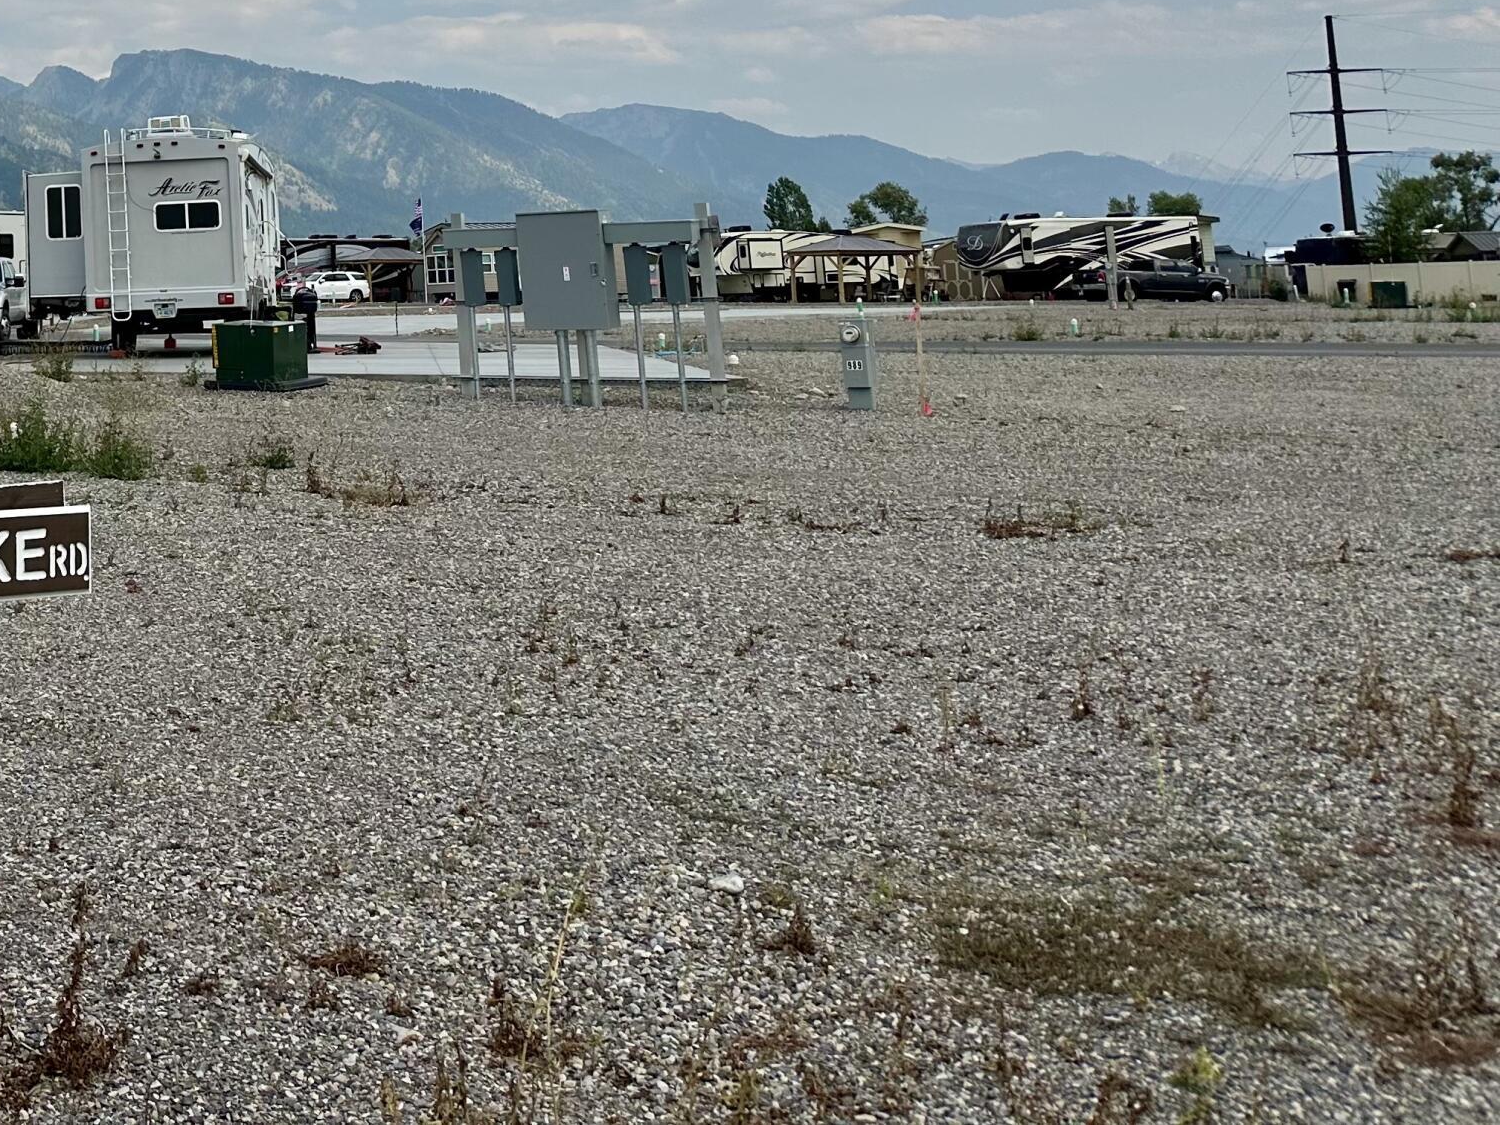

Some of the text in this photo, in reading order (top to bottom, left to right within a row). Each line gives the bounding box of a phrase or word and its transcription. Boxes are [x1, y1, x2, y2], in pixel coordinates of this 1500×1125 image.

[148, 177, 223, 199] Arctic Fox
[847, 361, 862, 370] 989
